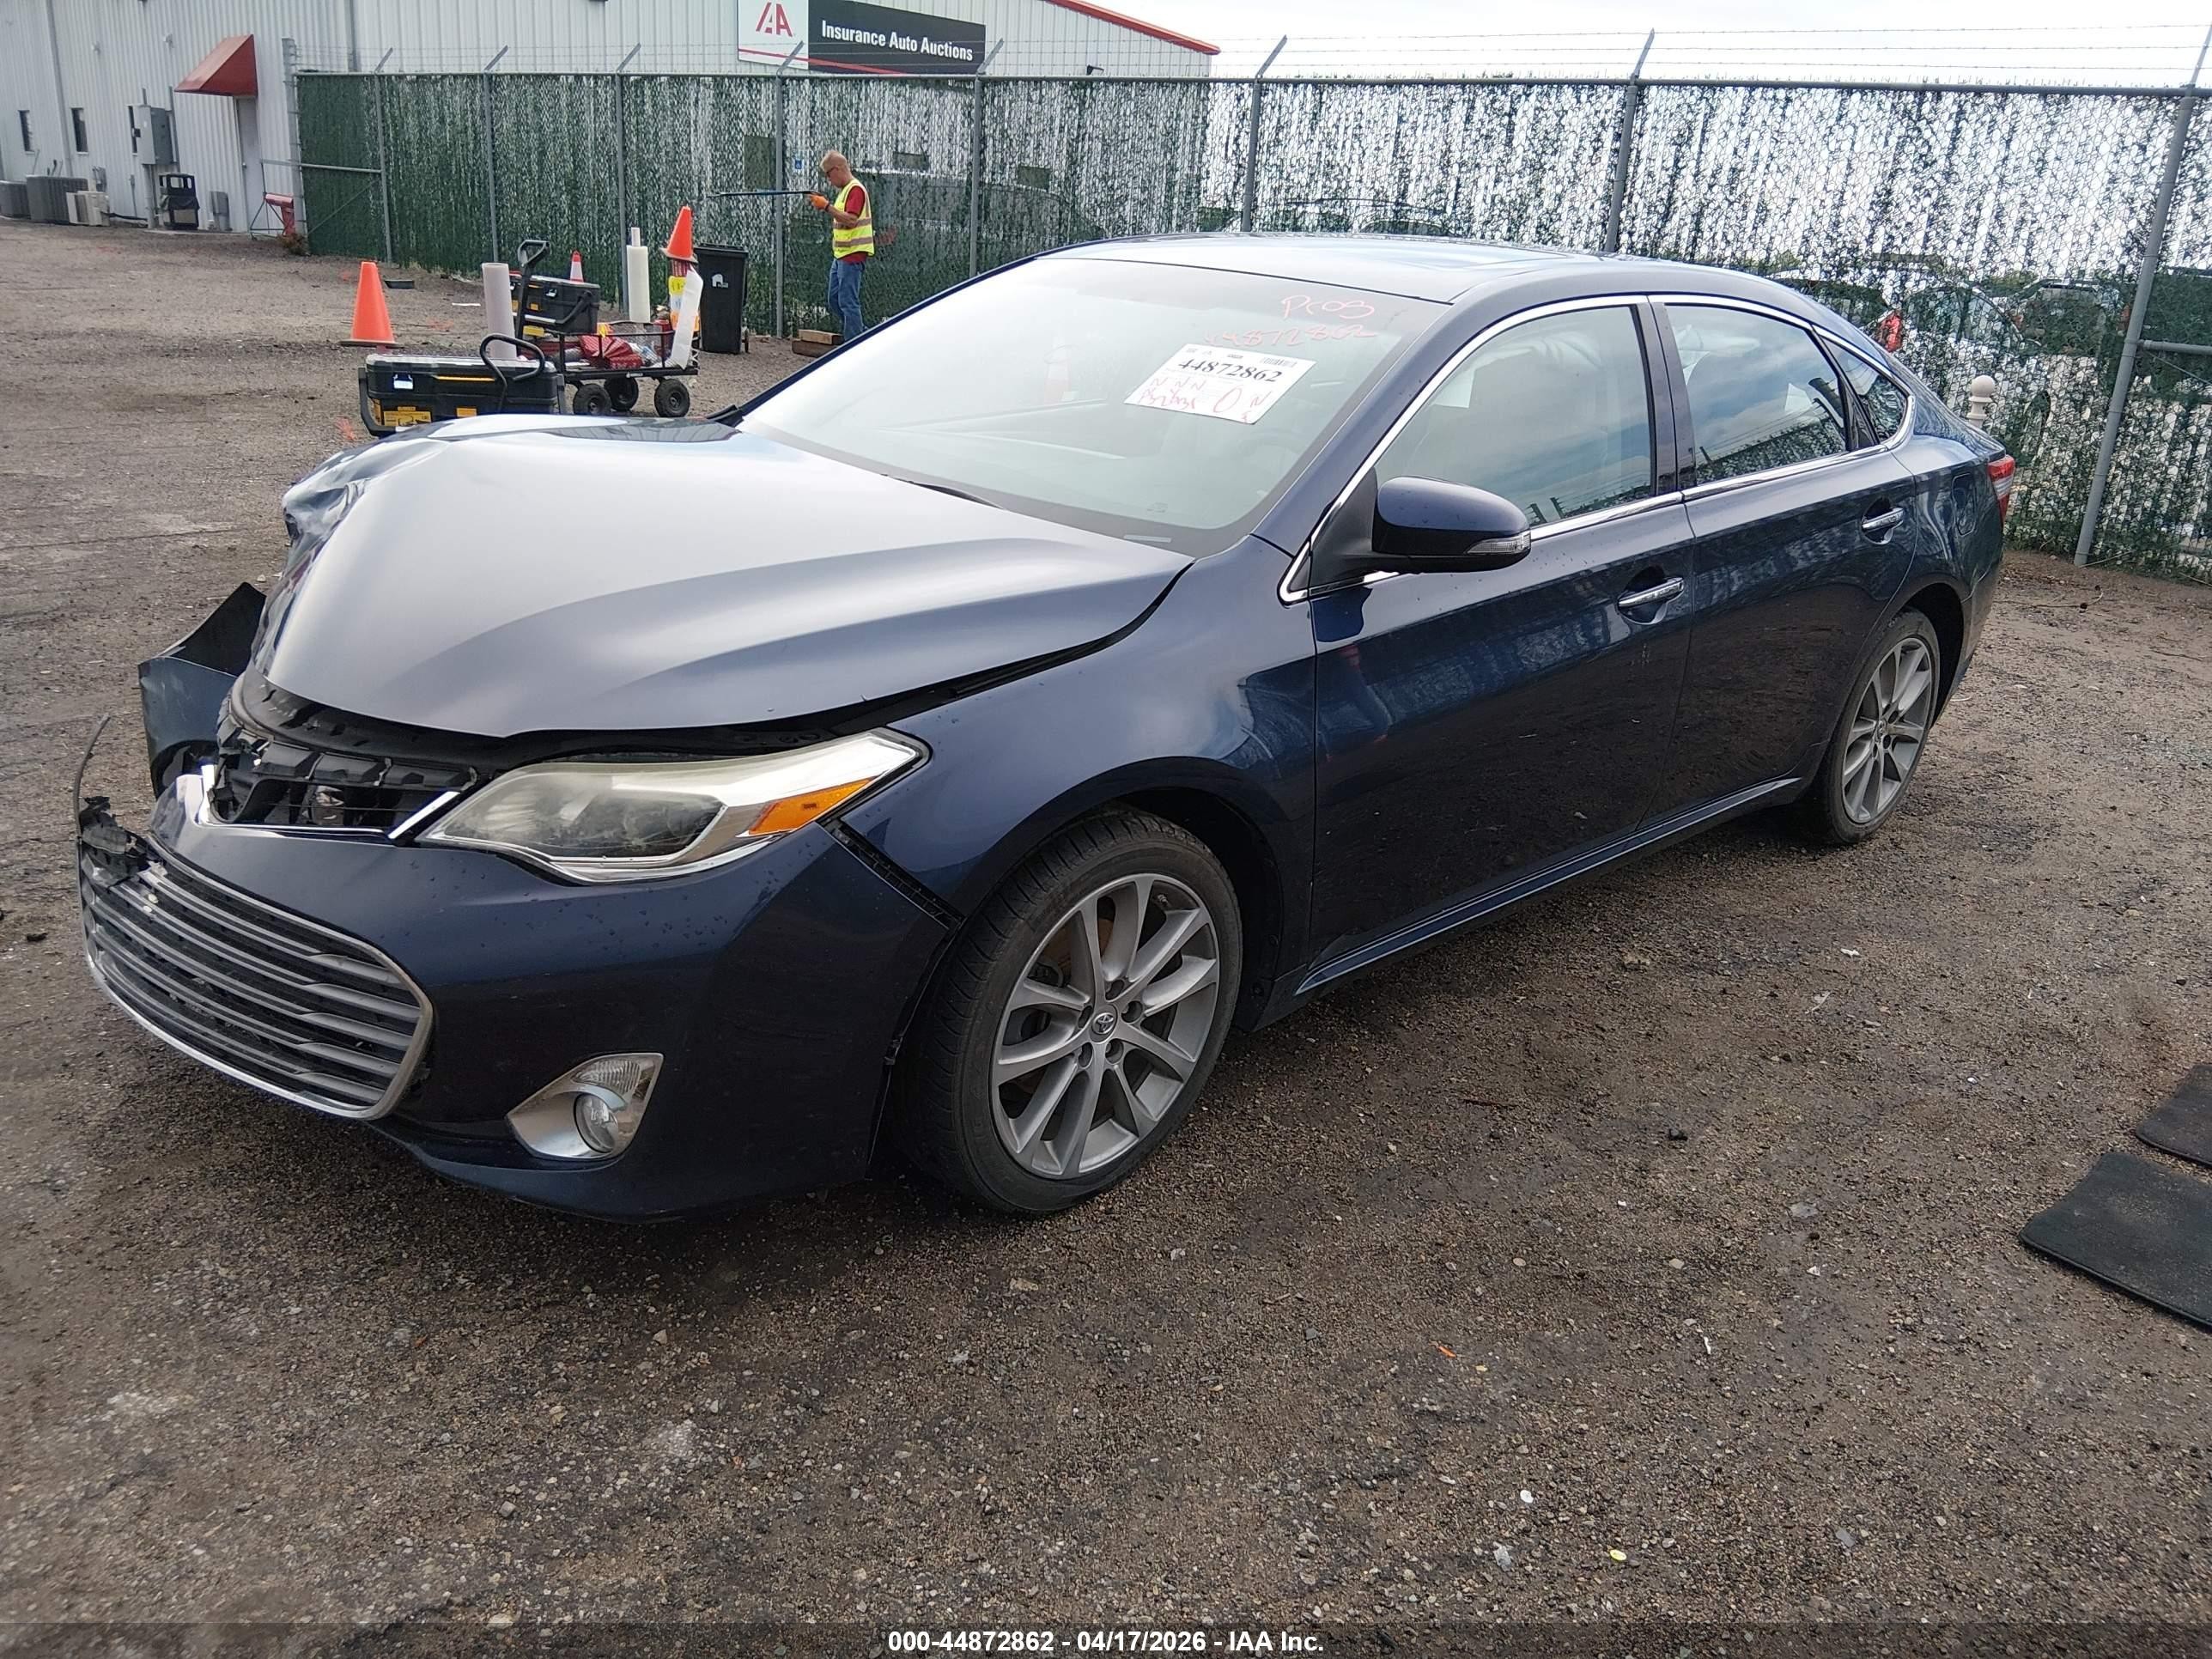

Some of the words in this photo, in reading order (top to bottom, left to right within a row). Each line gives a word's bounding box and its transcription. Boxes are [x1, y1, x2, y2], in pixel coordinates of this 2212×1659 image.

[821, 20, 886, 46] Insurance
[889, 32, 918, 52] Auto
[920, 37, 974, 62] Auctions
[1179, 358, 1282, 382] 44872862
